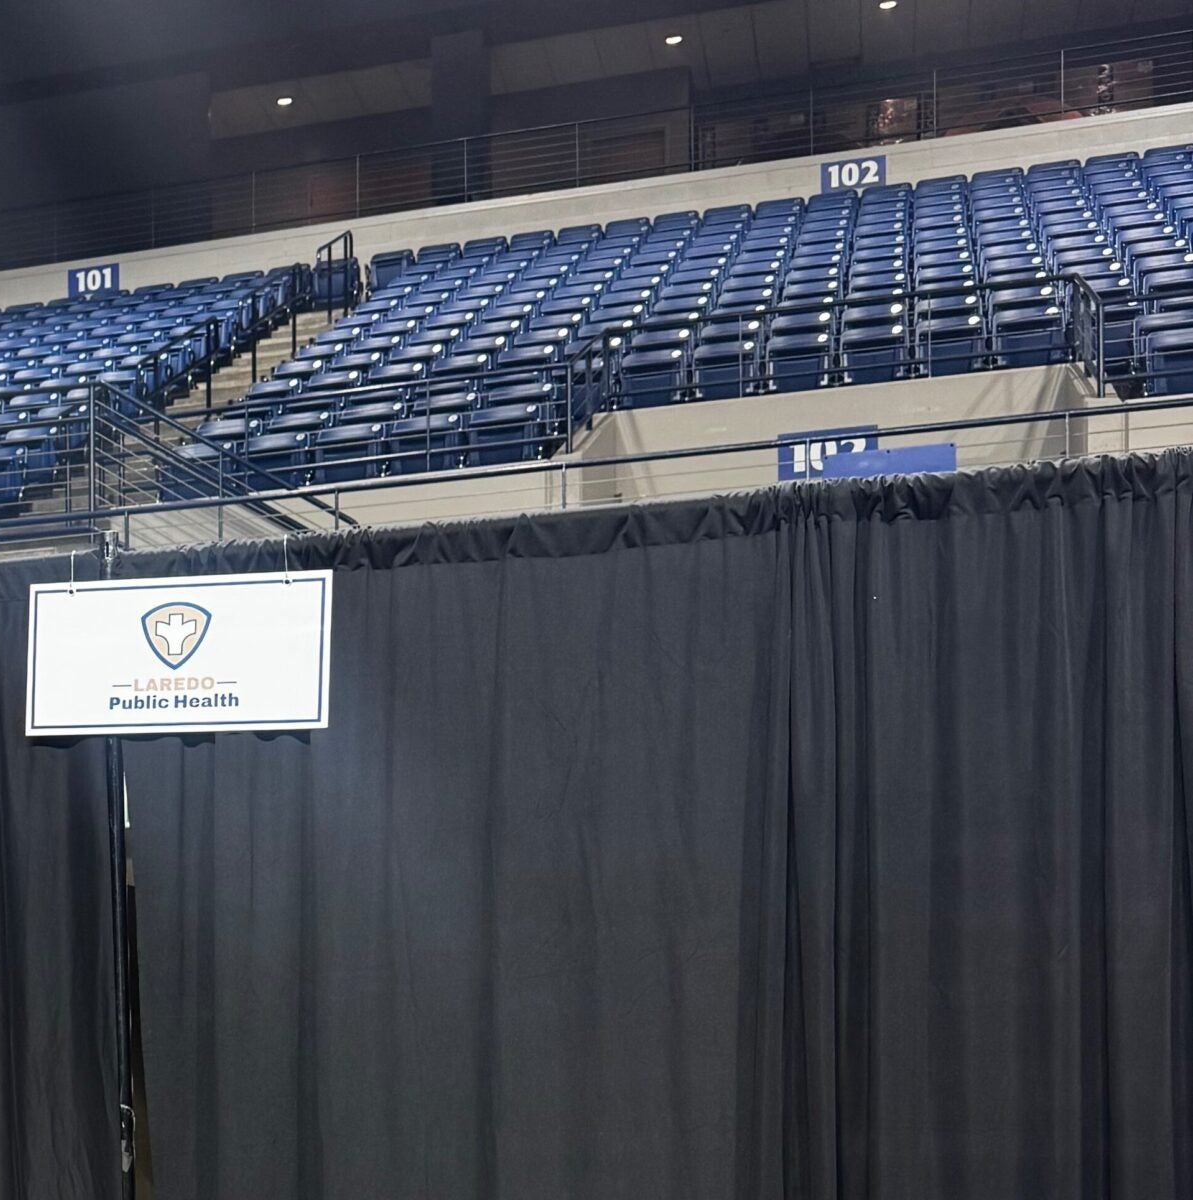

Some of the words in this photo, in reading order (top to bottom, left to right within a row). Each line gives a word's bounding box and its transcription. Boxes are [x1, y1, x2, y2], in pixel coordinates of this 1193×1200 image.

[828, 160, 879, 188] 102
[75, 267, 112, 293] 101
[134, 677, 215, 692] LAREDO
[109, 695, 169, 710] Public
[174, 693, 239, 708] Health
